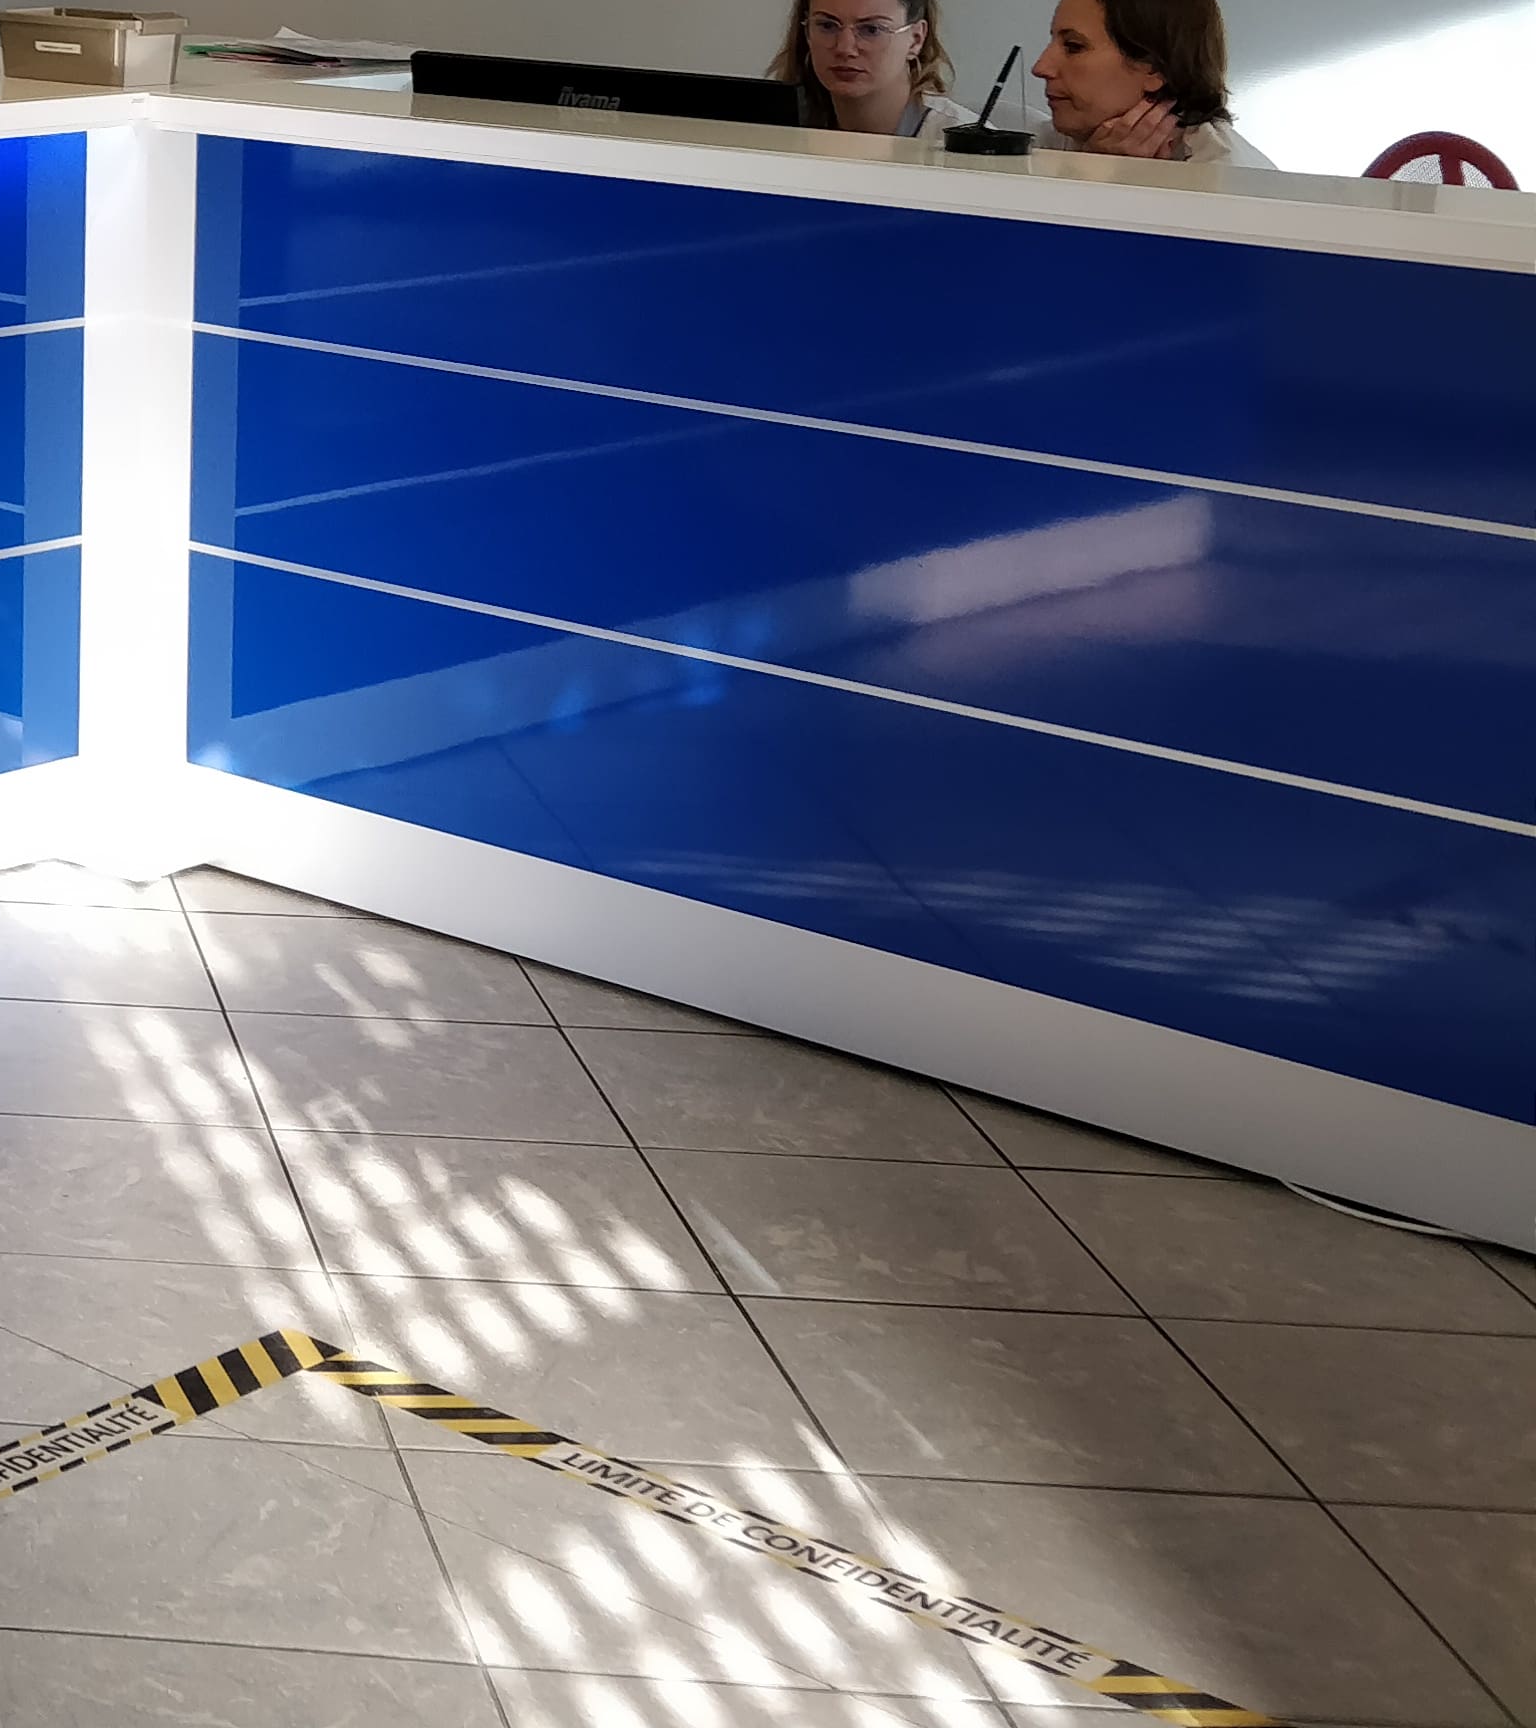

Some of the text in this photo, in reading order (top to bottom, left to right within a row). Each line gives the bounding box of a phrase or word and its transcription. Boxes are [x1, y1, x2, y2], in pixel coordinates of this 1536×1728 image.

[561, 1452, 1094, 1670] LIMITE DE CONFIDENTIALITÉ
